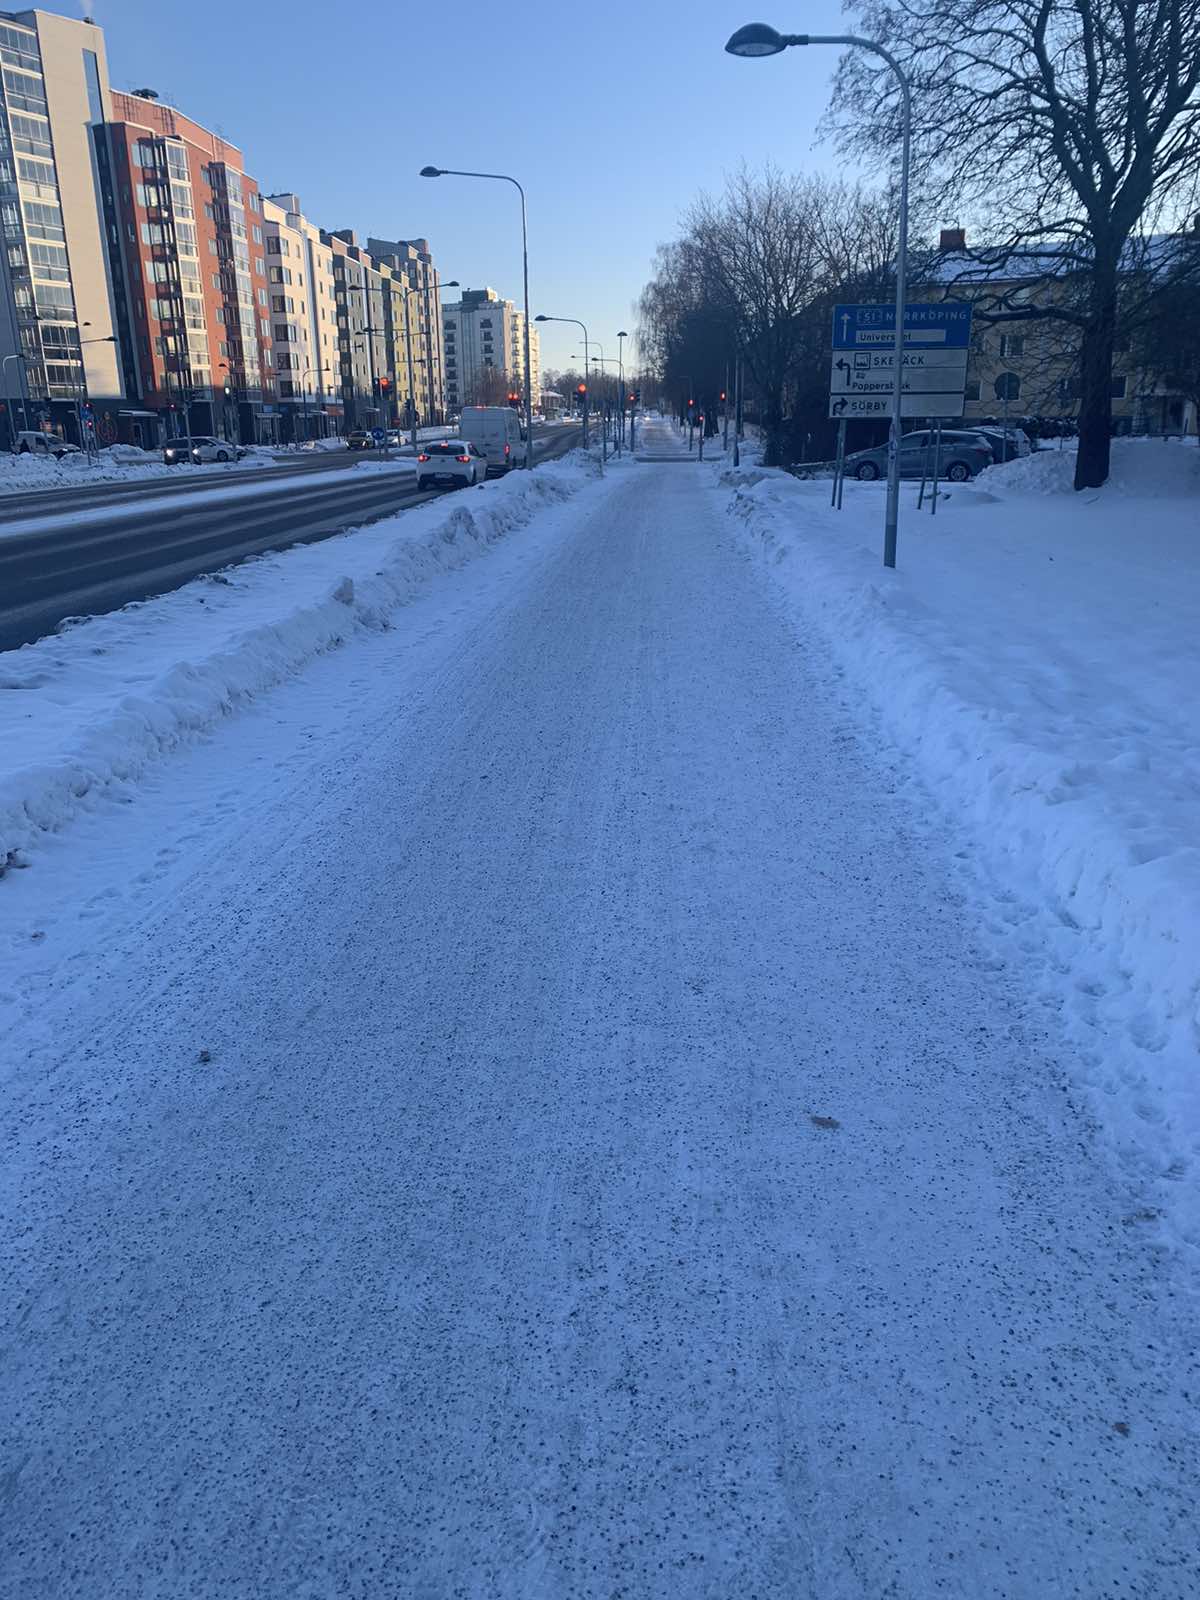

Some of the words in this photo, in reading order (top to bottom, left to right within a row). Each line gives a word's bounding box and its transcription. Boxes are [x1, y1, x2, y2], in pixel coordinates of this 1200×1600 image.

[886, 310, 967, 321] NRRKÖPING
[860, 333, 912, 341] Universet
[873, 354, 925, 366] SKEÄCK
[851, 400, 888, 410] SÖRBY
